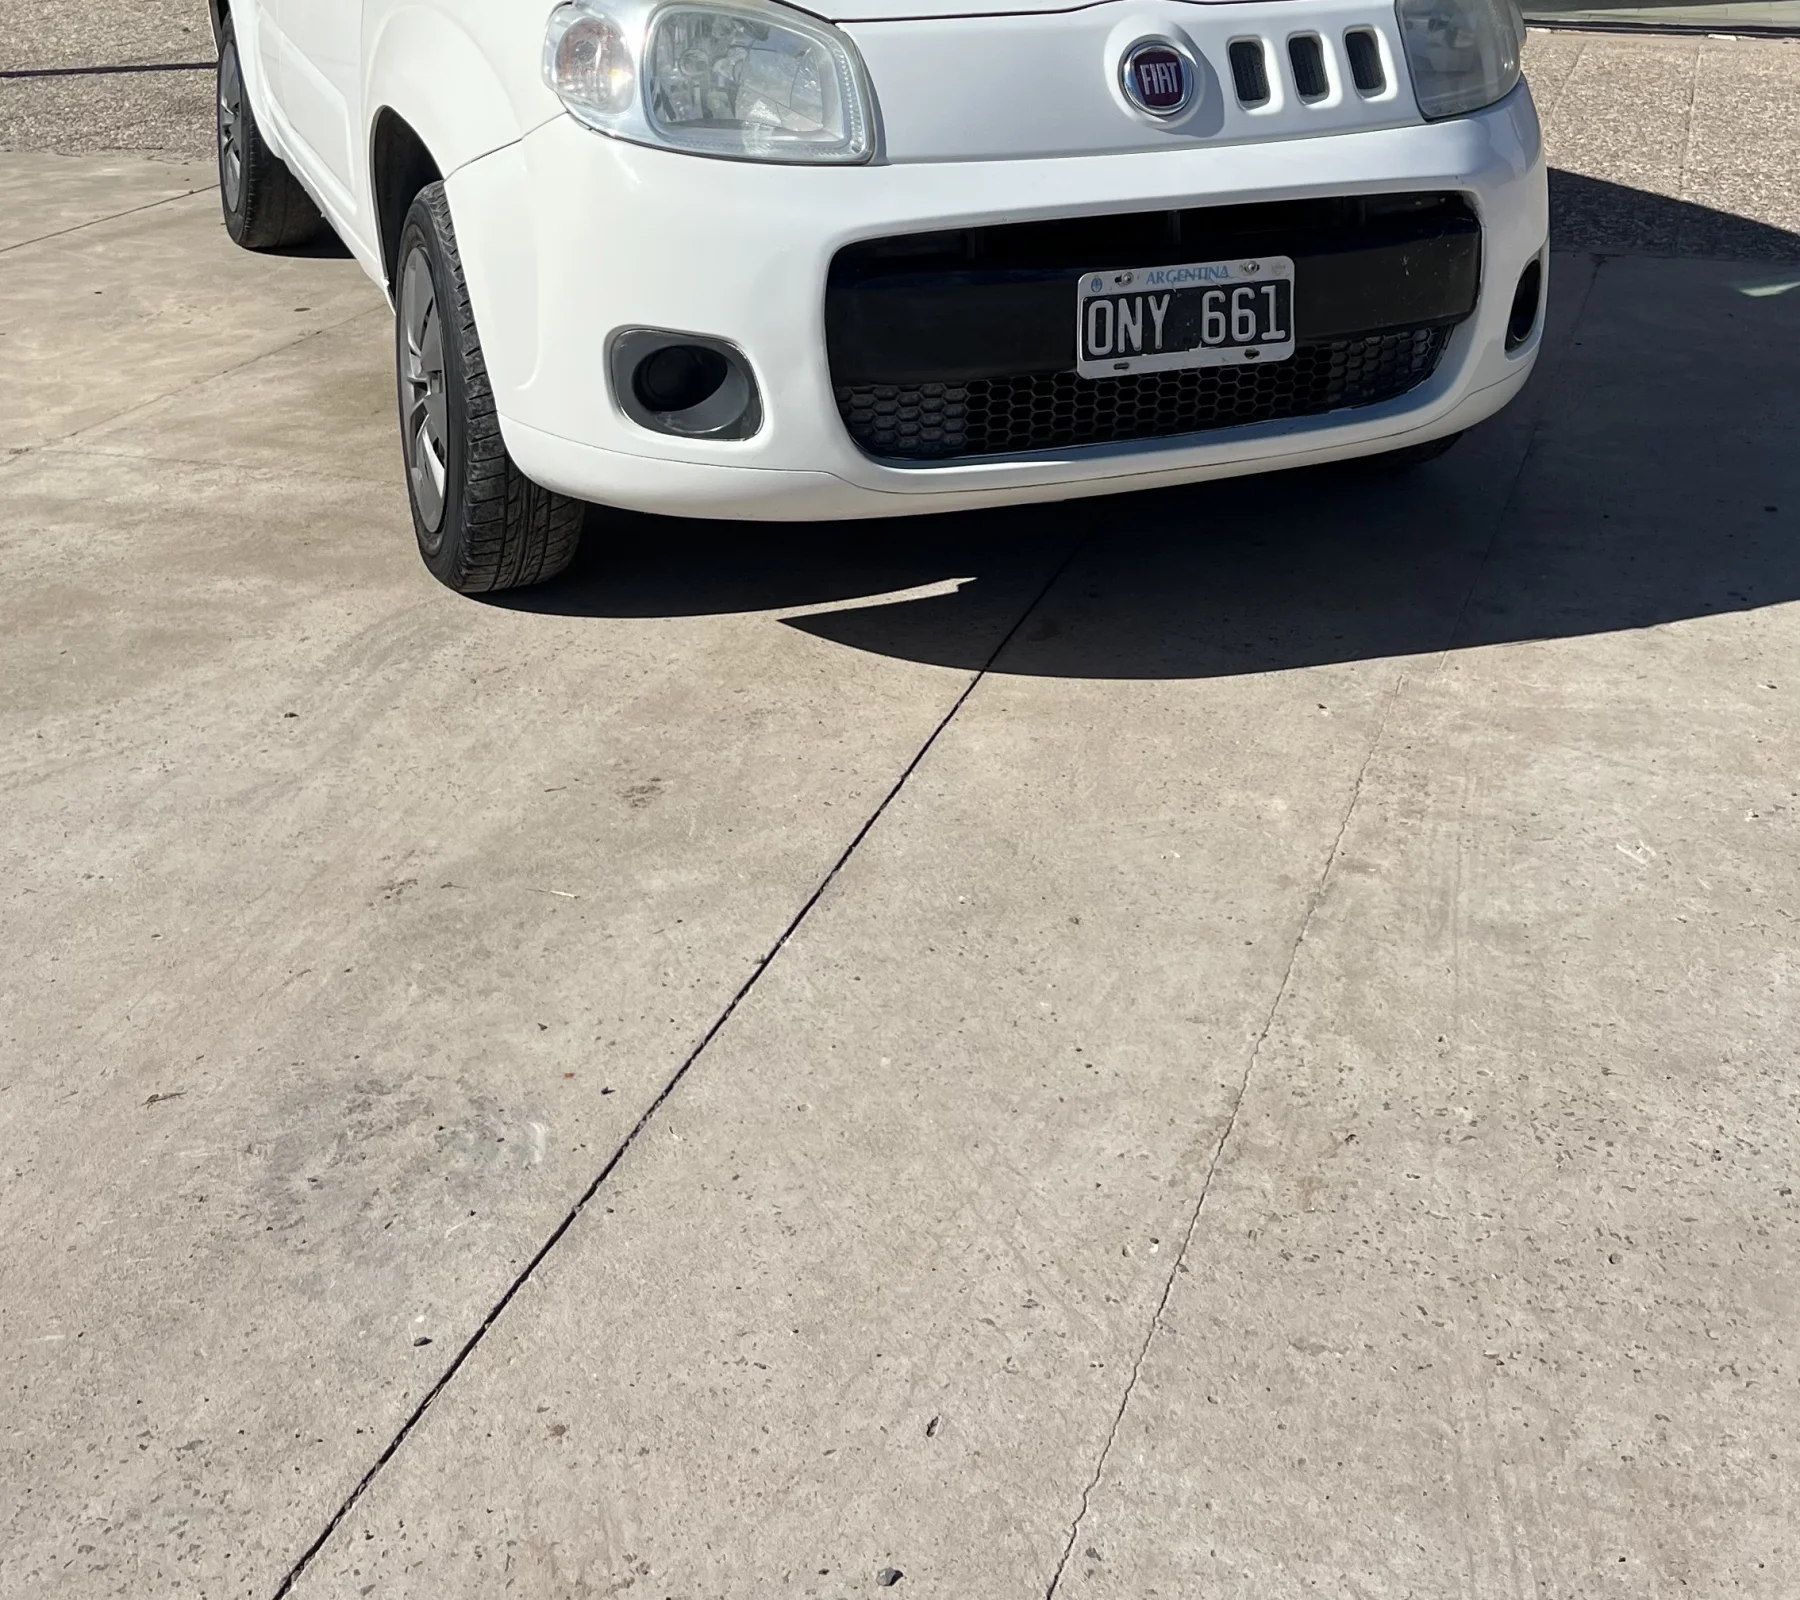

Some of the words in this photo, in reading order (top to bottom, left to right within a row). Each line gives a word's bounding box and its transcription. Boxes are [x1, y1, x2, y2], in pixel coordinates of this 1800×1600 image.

[1140, 62, 1179, 95] FIAT
[1146, 265, 1229, 285] ARGENTINA
[1088, 294, 1170, 356] ONY
[1201, 285, 1286, 345] 661
